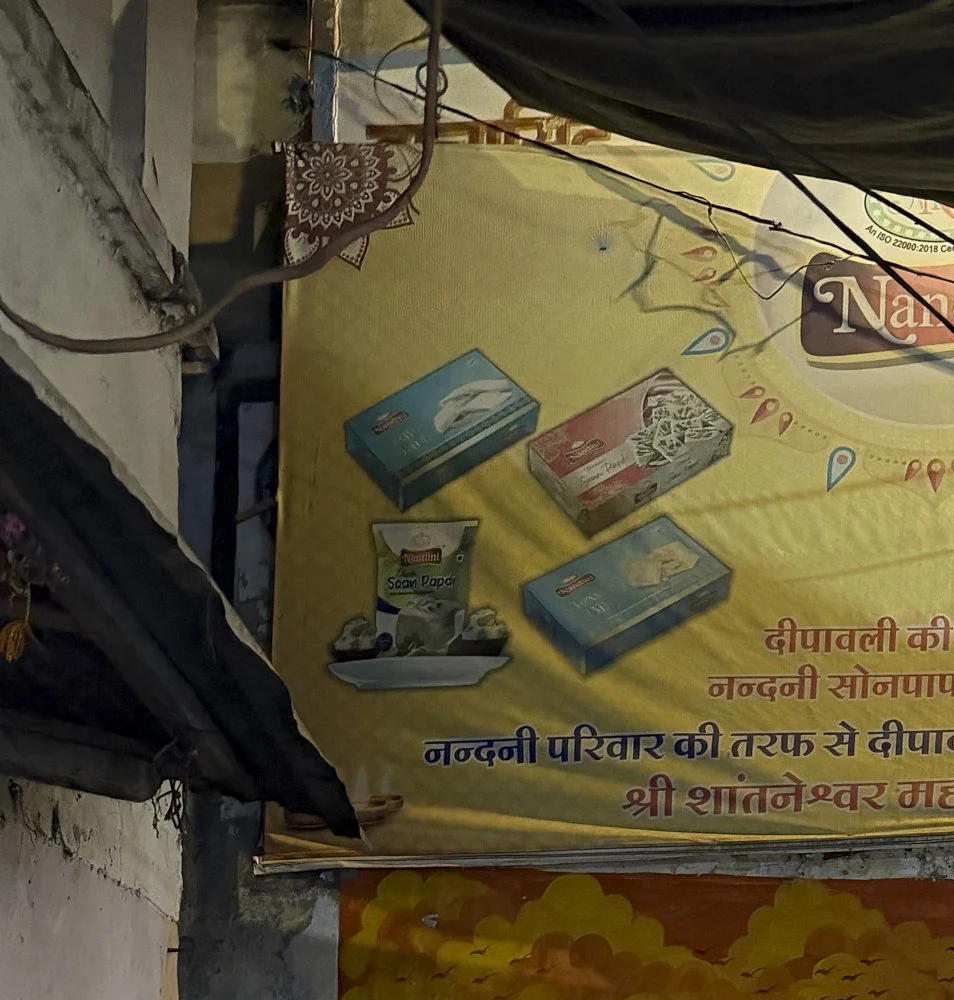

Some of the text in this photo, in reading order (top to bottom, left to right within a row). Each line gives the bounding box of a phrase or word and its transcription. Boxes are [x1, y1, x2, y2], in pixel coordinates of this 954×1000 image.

[865, 224, 877, 236] An
[877, 232, 892, 244] ISO
[892, 239, 938, 253] 22000:2018
[764, 615, 899, 654] दीपावली
[906, 615, 952, 652] की
[708, 663, 819, 702] नन्दनी
[424, 725, 540, 767] नन्दनी
[547, 723, 665, 763] परिवार
[673, 721, 723, 760] की
[730, 731, 817, 759] तरफ
[823, 720, 858, 757] से
[622, 773, 676, 818] श्री
[687, 771, 888, 816] शांतनेश्वर
